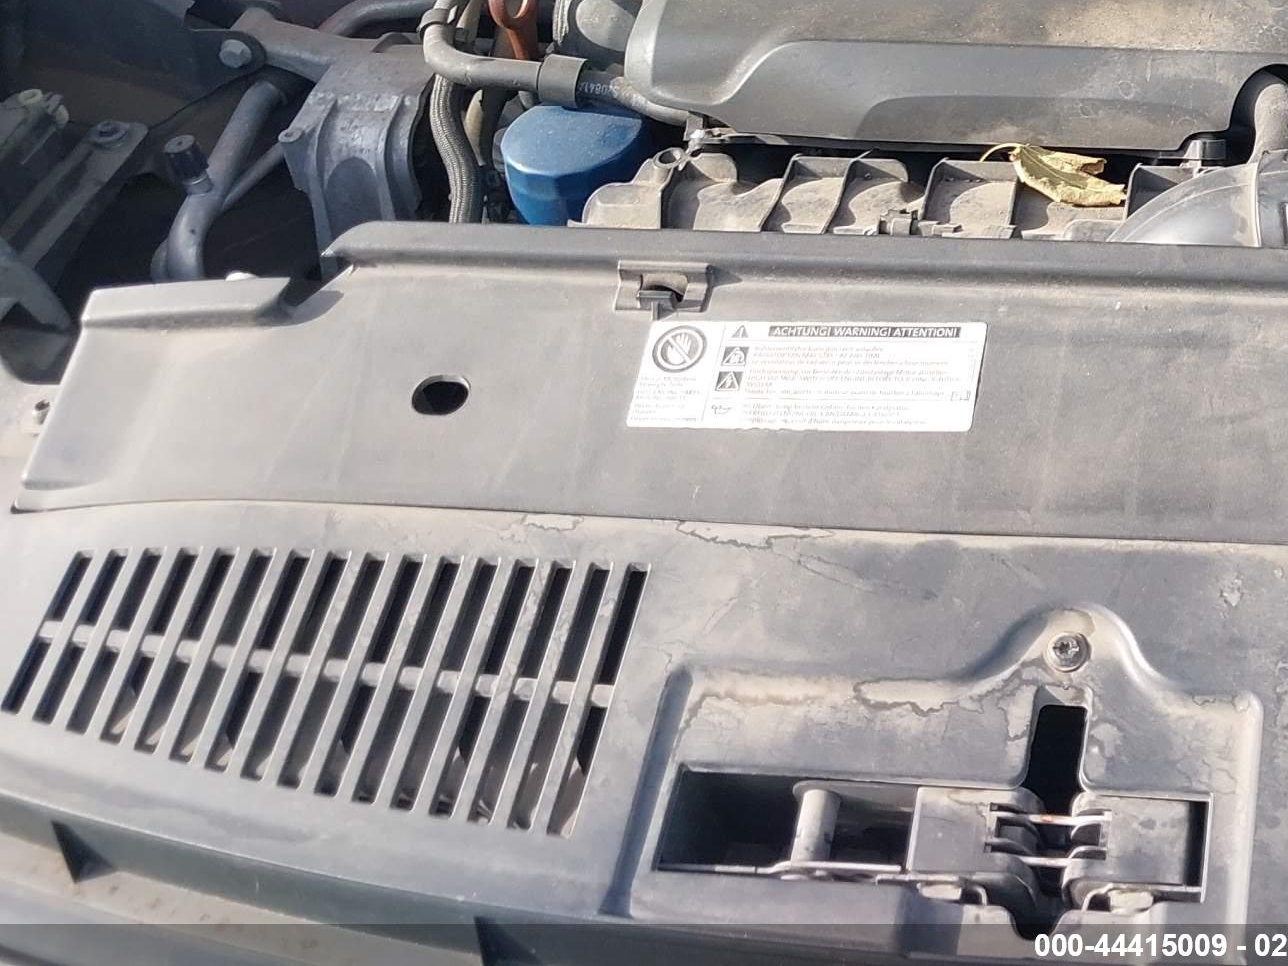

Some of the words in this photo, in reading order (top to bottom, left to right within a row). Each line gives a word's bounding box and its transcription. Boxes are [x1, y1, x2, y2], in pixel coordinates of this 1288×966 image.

[773, 326, 832, 337] ACHTUNG!
[833, 326, 892, 338] WARNING!
[893, 326, 958, 338] ATTENTION!
